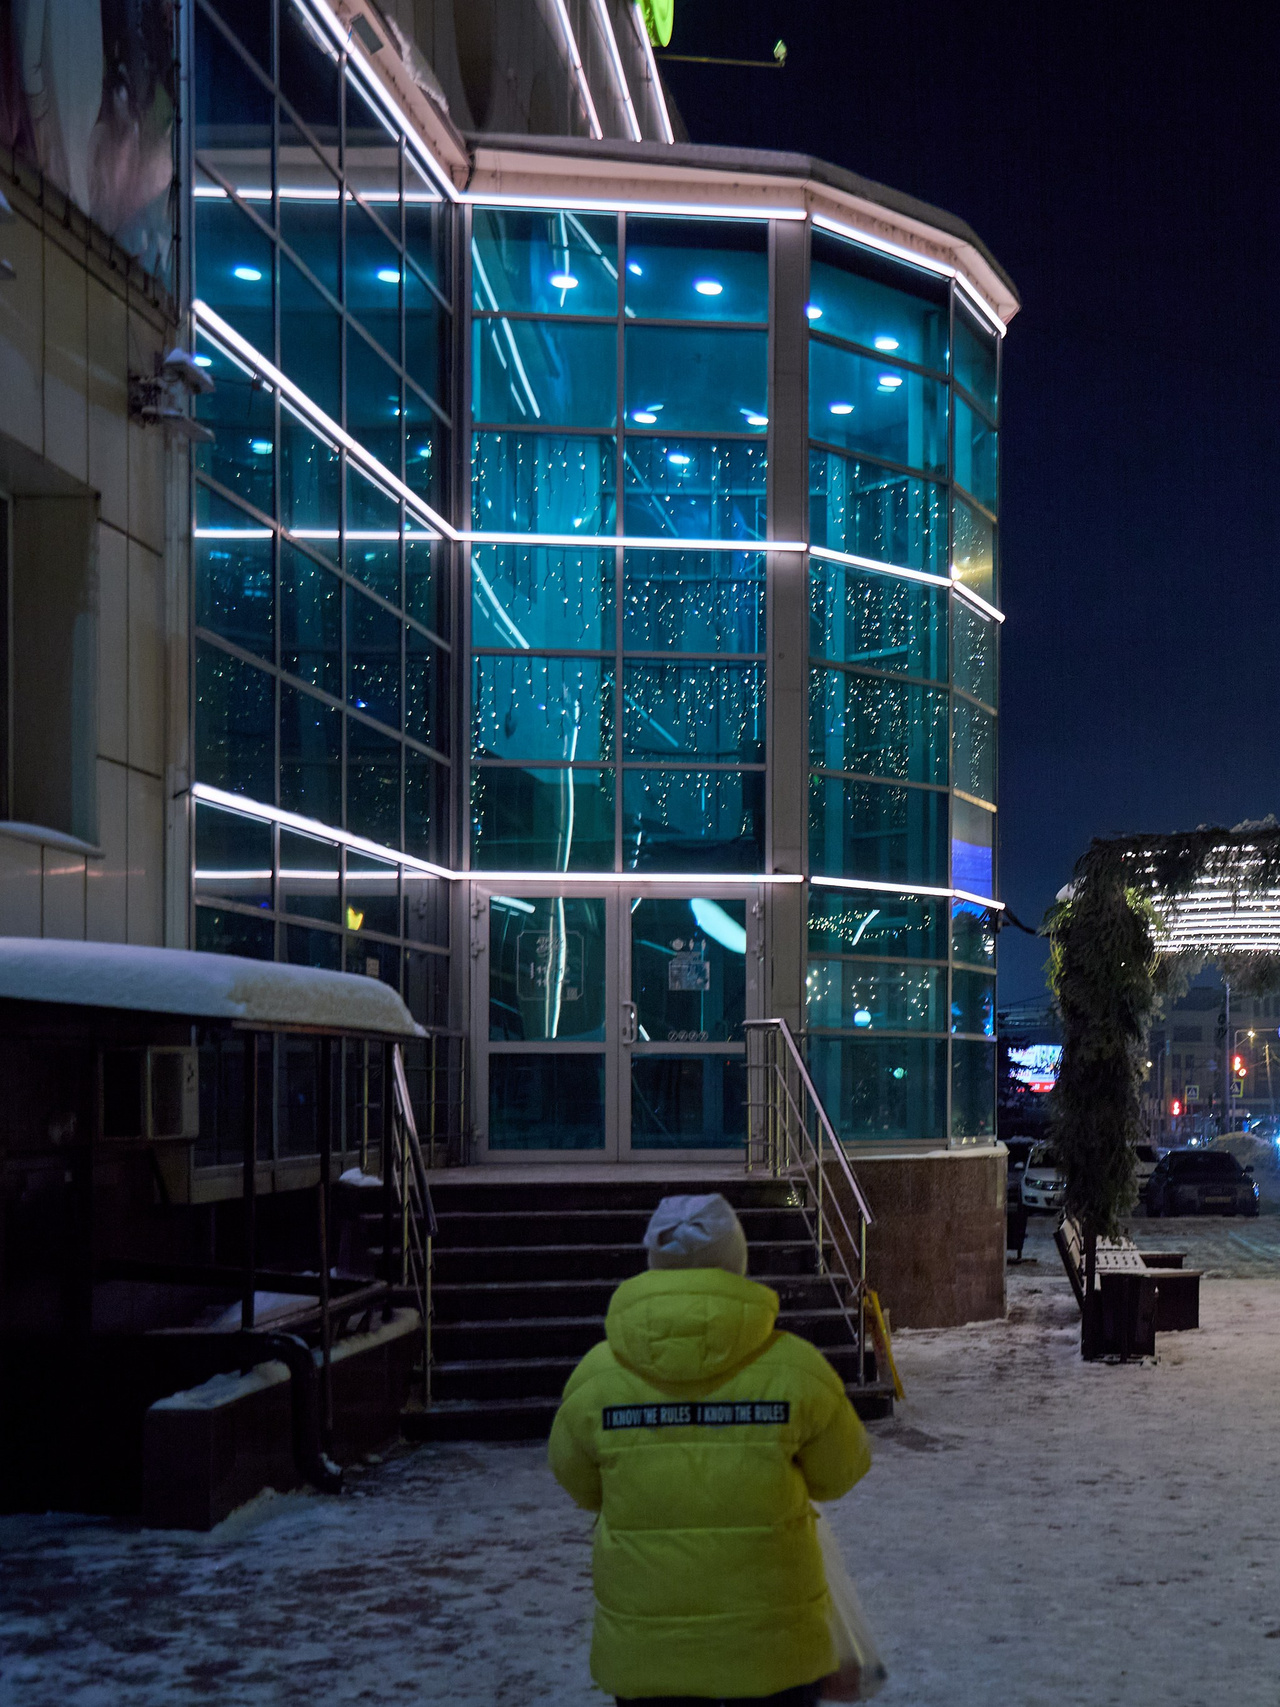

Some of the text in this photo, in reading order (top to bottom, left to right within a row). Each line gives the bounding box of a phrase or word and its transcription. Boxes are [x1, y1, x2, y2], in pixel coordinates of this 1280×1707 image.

[607, 1411, 610, 1426] I
[612, 1408, 641, 1426] KNOW
[660, 1405, 691, 1423] RULES
[704, 1405, 733, 1422] KNOW
[735, 1405, 752, 1422] THE
[754, 1404, 785, 1421] RULES
